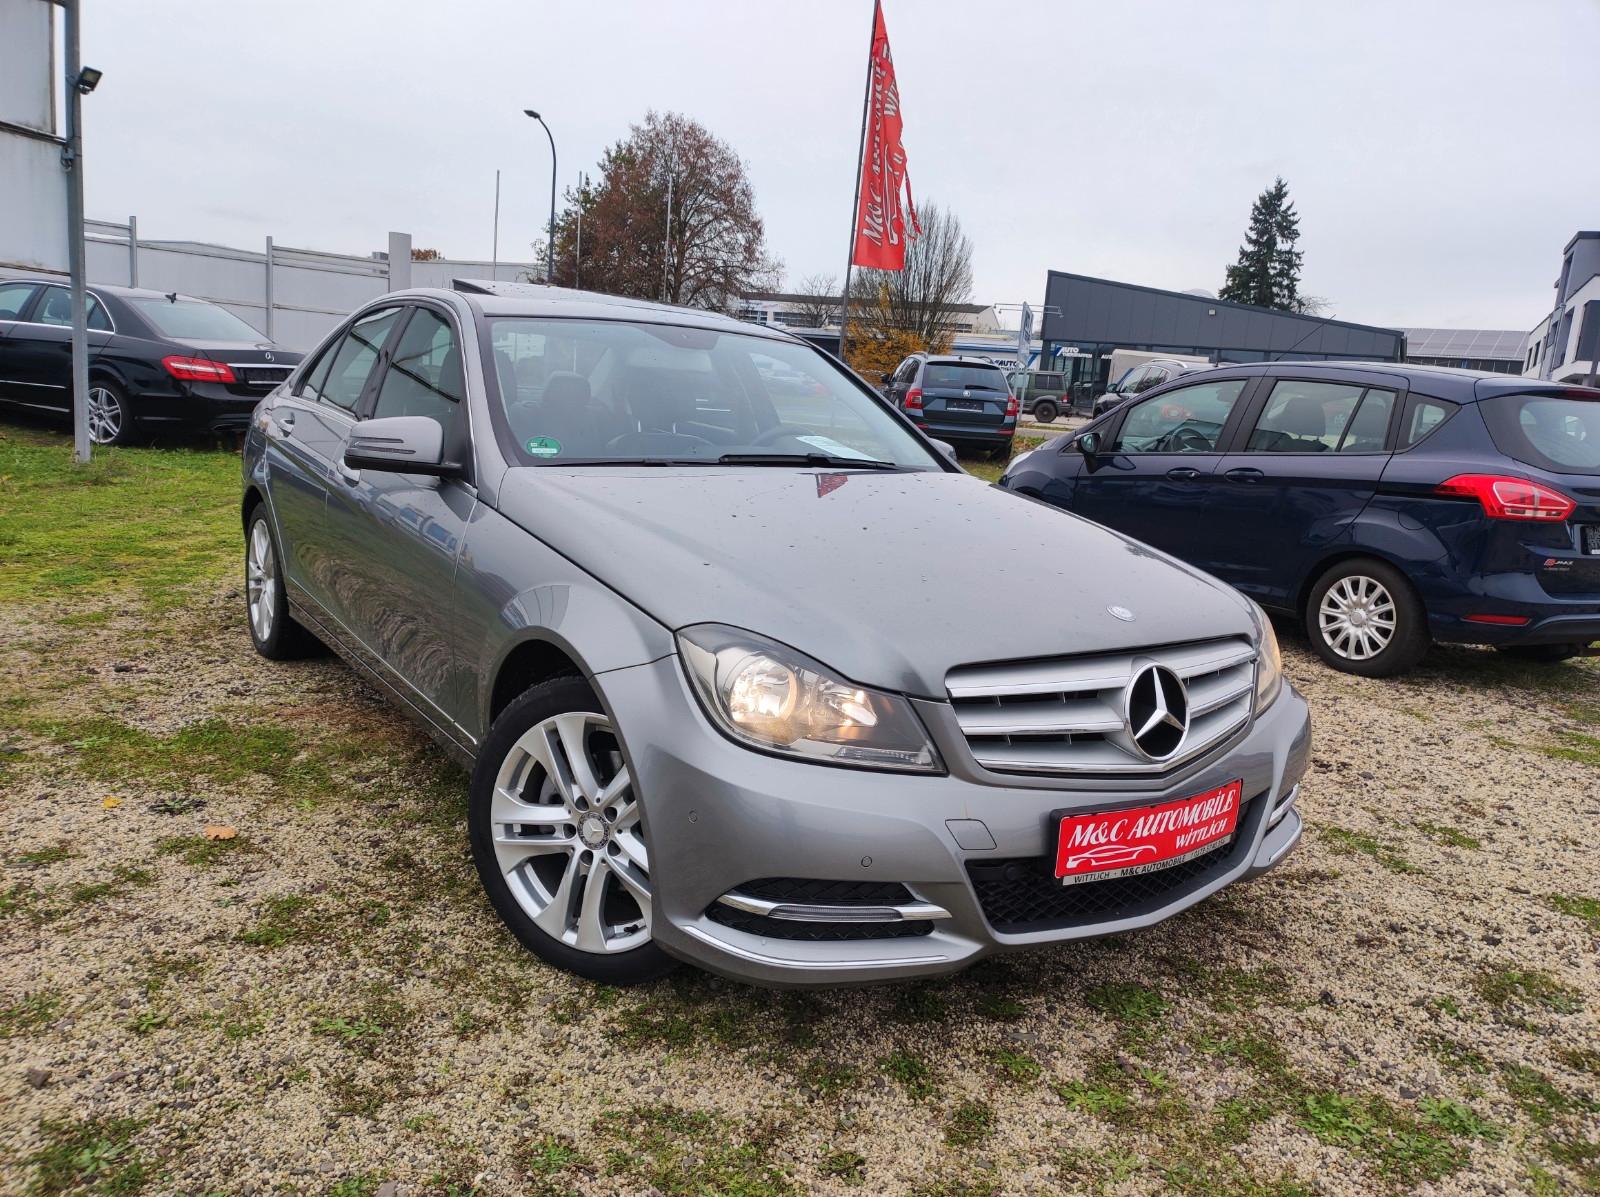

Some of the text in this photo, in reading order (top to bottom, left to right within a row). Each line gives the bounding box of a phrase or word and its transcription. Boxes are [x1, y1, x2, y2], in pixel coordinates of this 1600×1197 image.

[1067, 819, 1128, 848] M&C
[1073, 854, 1186, 884] WITTLICH M&C AUTOMOBILE
